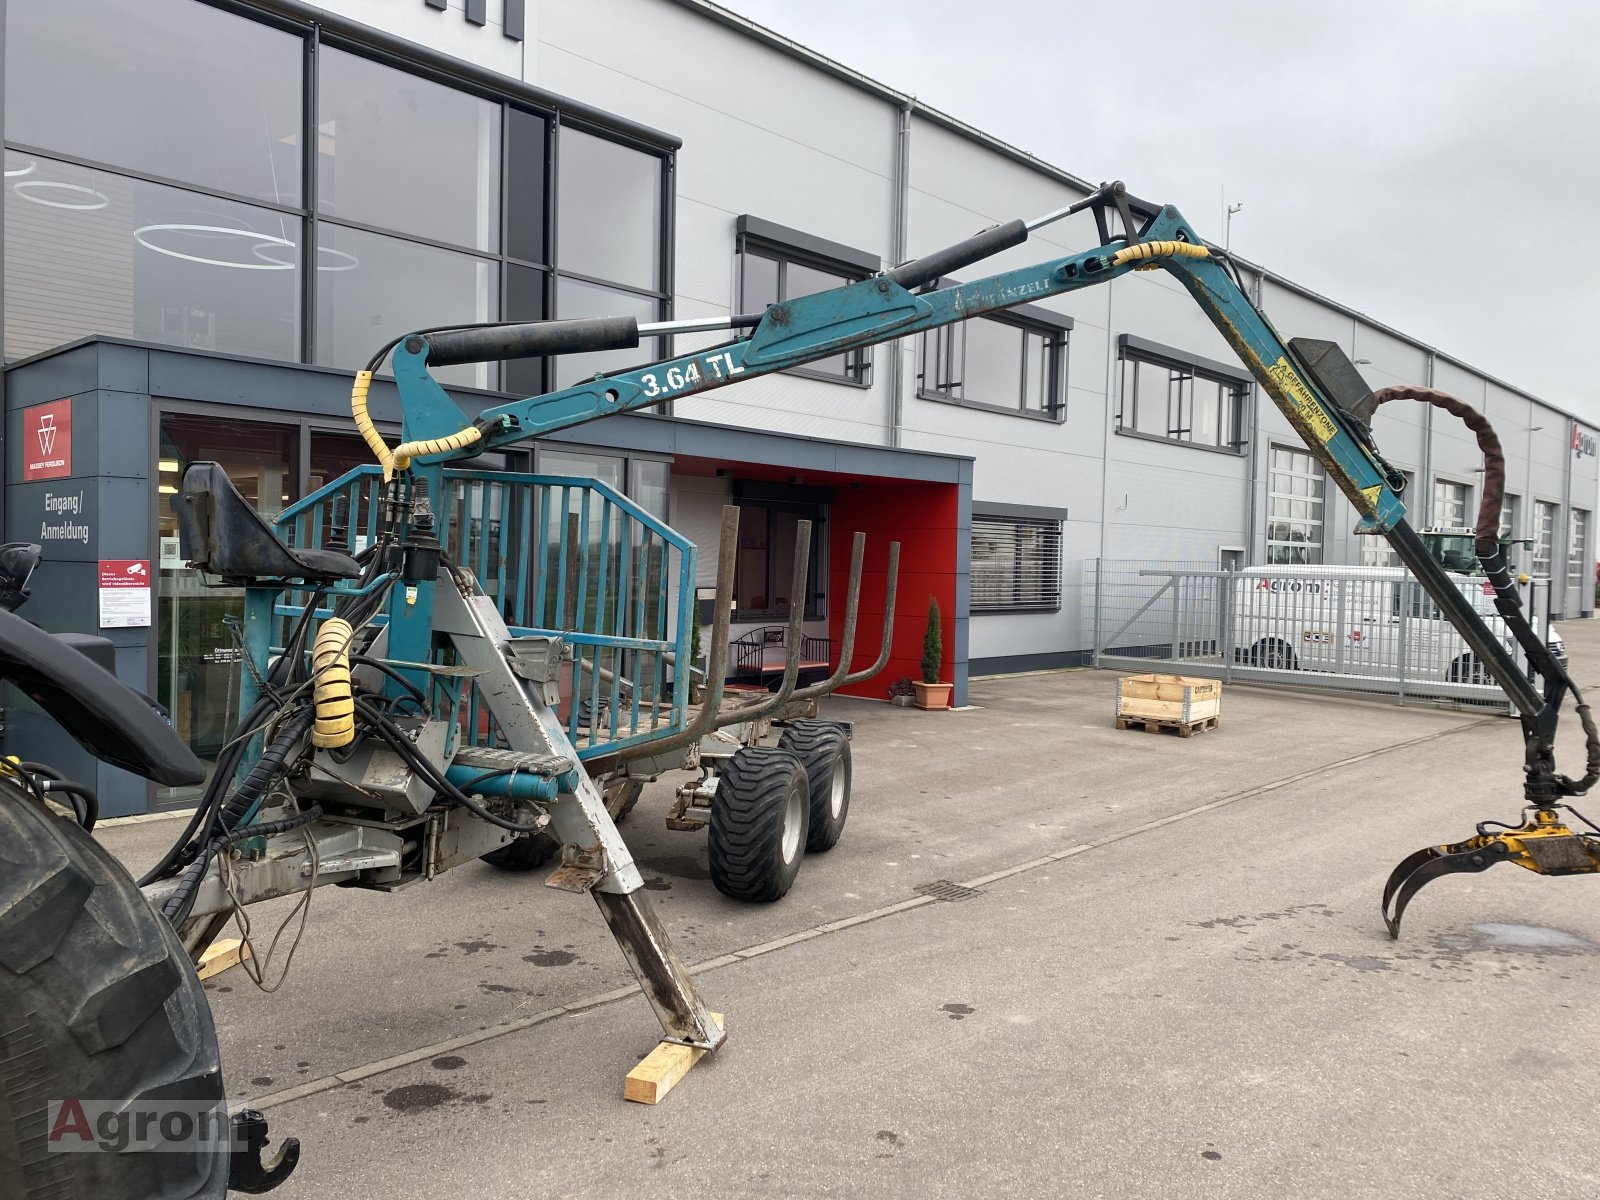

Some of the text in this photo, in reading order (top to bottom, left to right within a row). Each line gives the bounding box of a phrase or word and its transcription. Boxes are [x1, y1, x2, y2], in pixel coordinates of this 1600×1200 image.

[641, 352, 745, 397] 3.64 TL
[45, 490, 84, 515] Eingang/
[41, 521, 89, 544] Anmeldung
